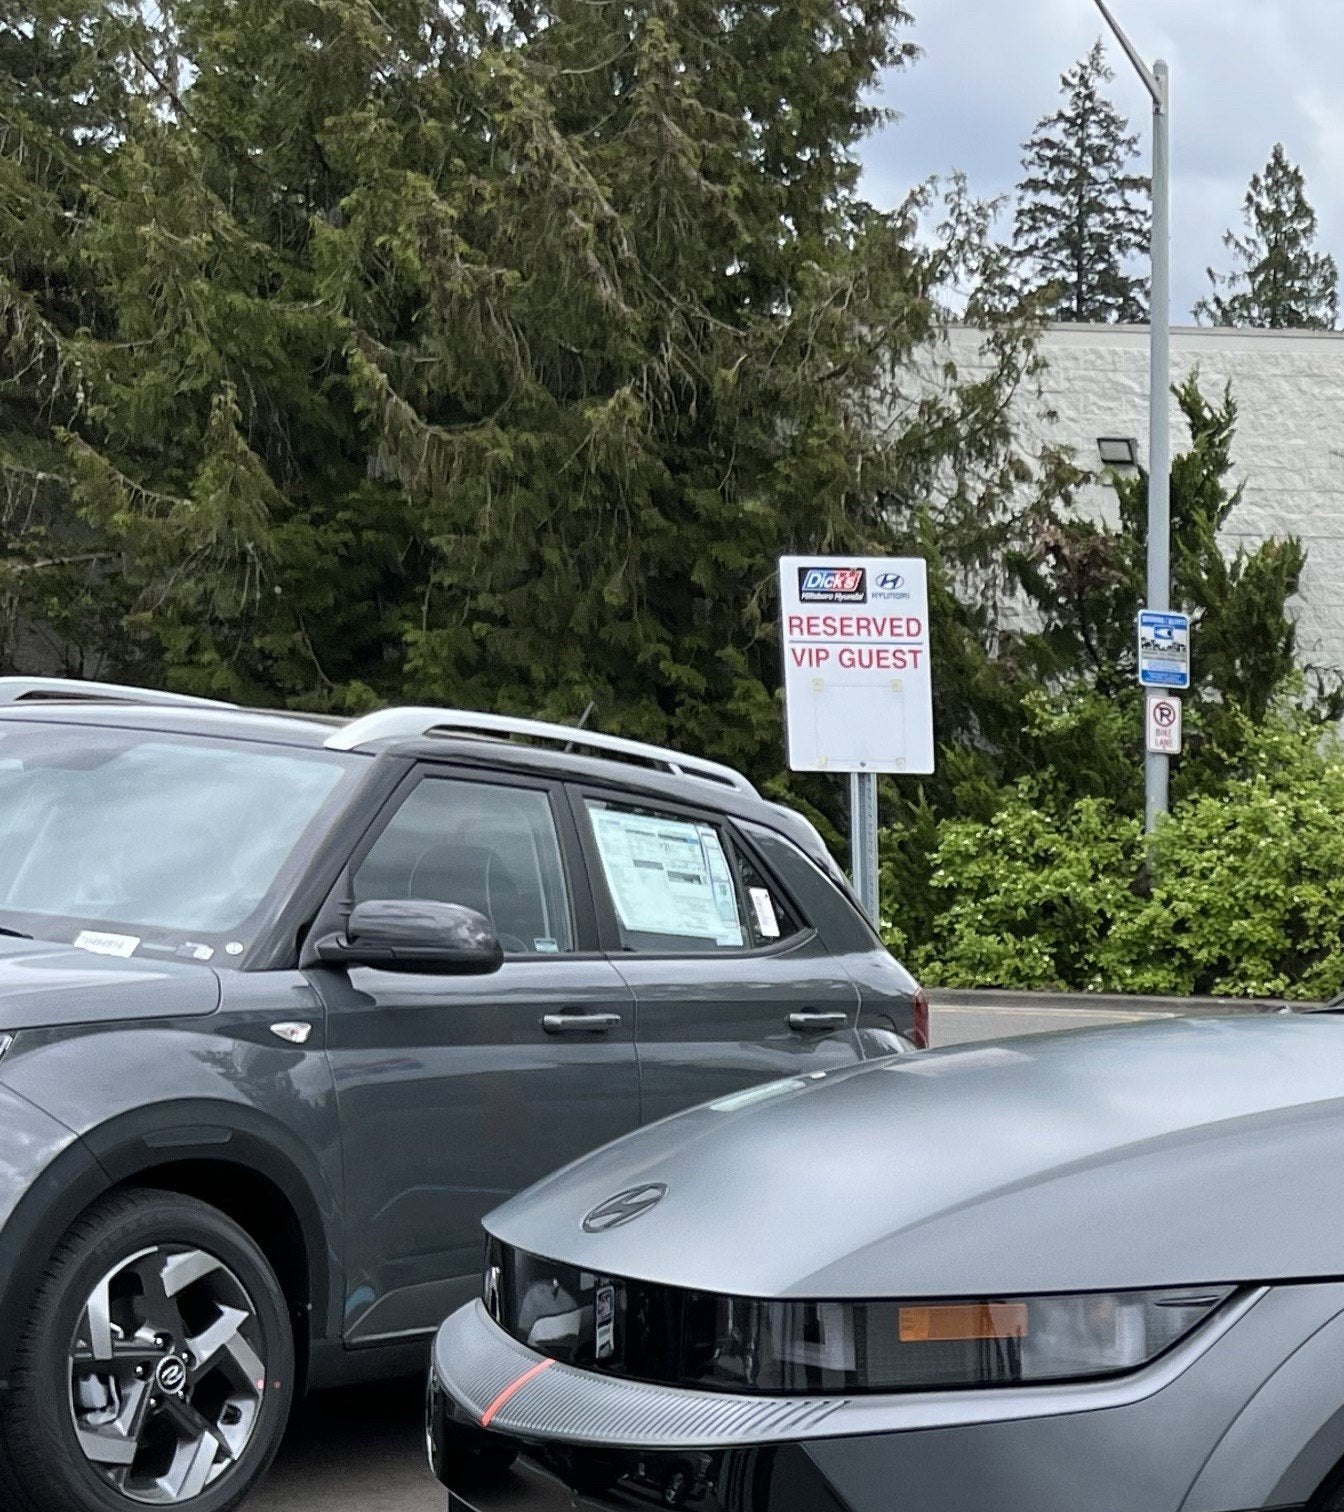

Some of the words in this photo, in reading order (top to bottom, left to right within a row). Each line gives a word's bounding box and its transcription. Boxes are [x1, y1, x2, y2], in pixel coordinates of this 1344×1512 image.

[788, 616, 922, 637] RESERVED
[791, 648, 830, 667] VIP
[838, 648, 922, 669] GUEST
